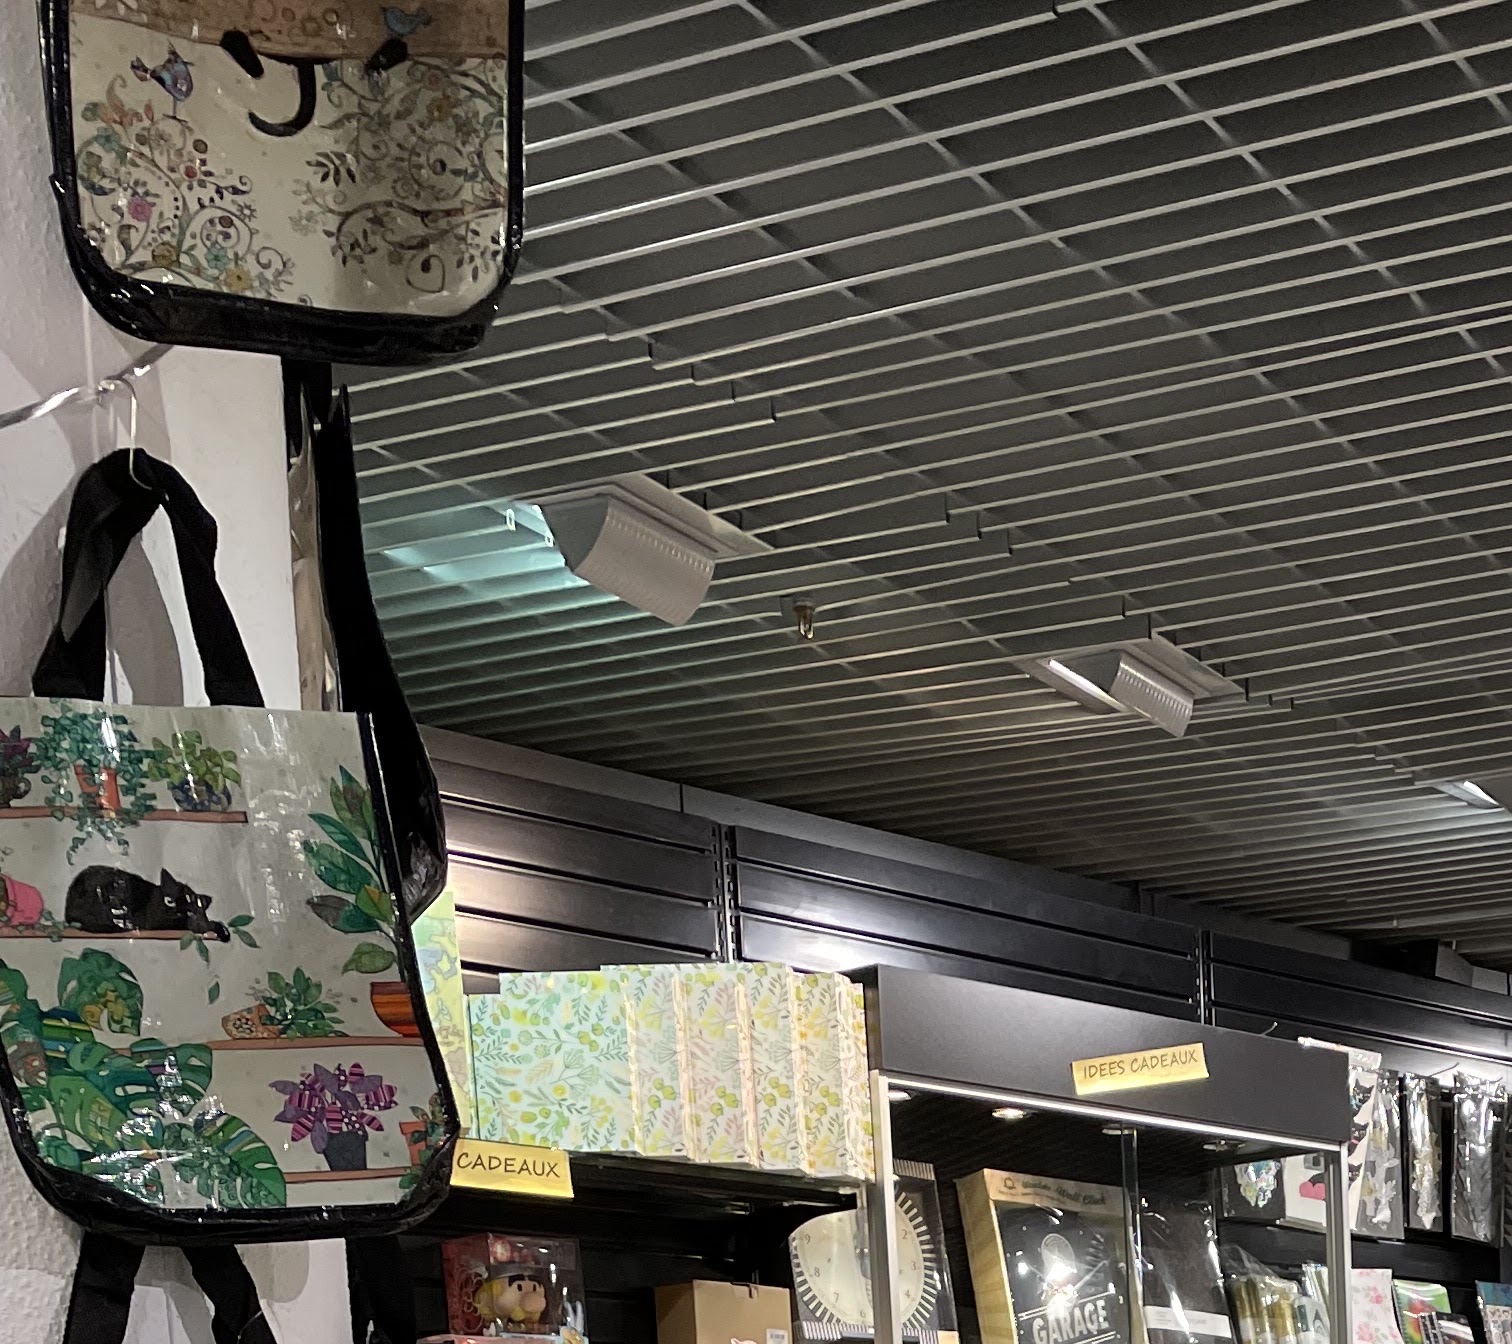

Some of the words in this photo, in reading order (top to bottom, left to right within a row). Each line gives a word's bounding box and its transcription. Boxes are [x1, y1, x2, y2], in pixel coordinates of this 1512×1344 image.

[1084, 1060, 1126, 1079] IDEES
[1130, 1049, 1198, 1073] CADEAUX
[456, 1152, 561, 1179] CADEAUX
